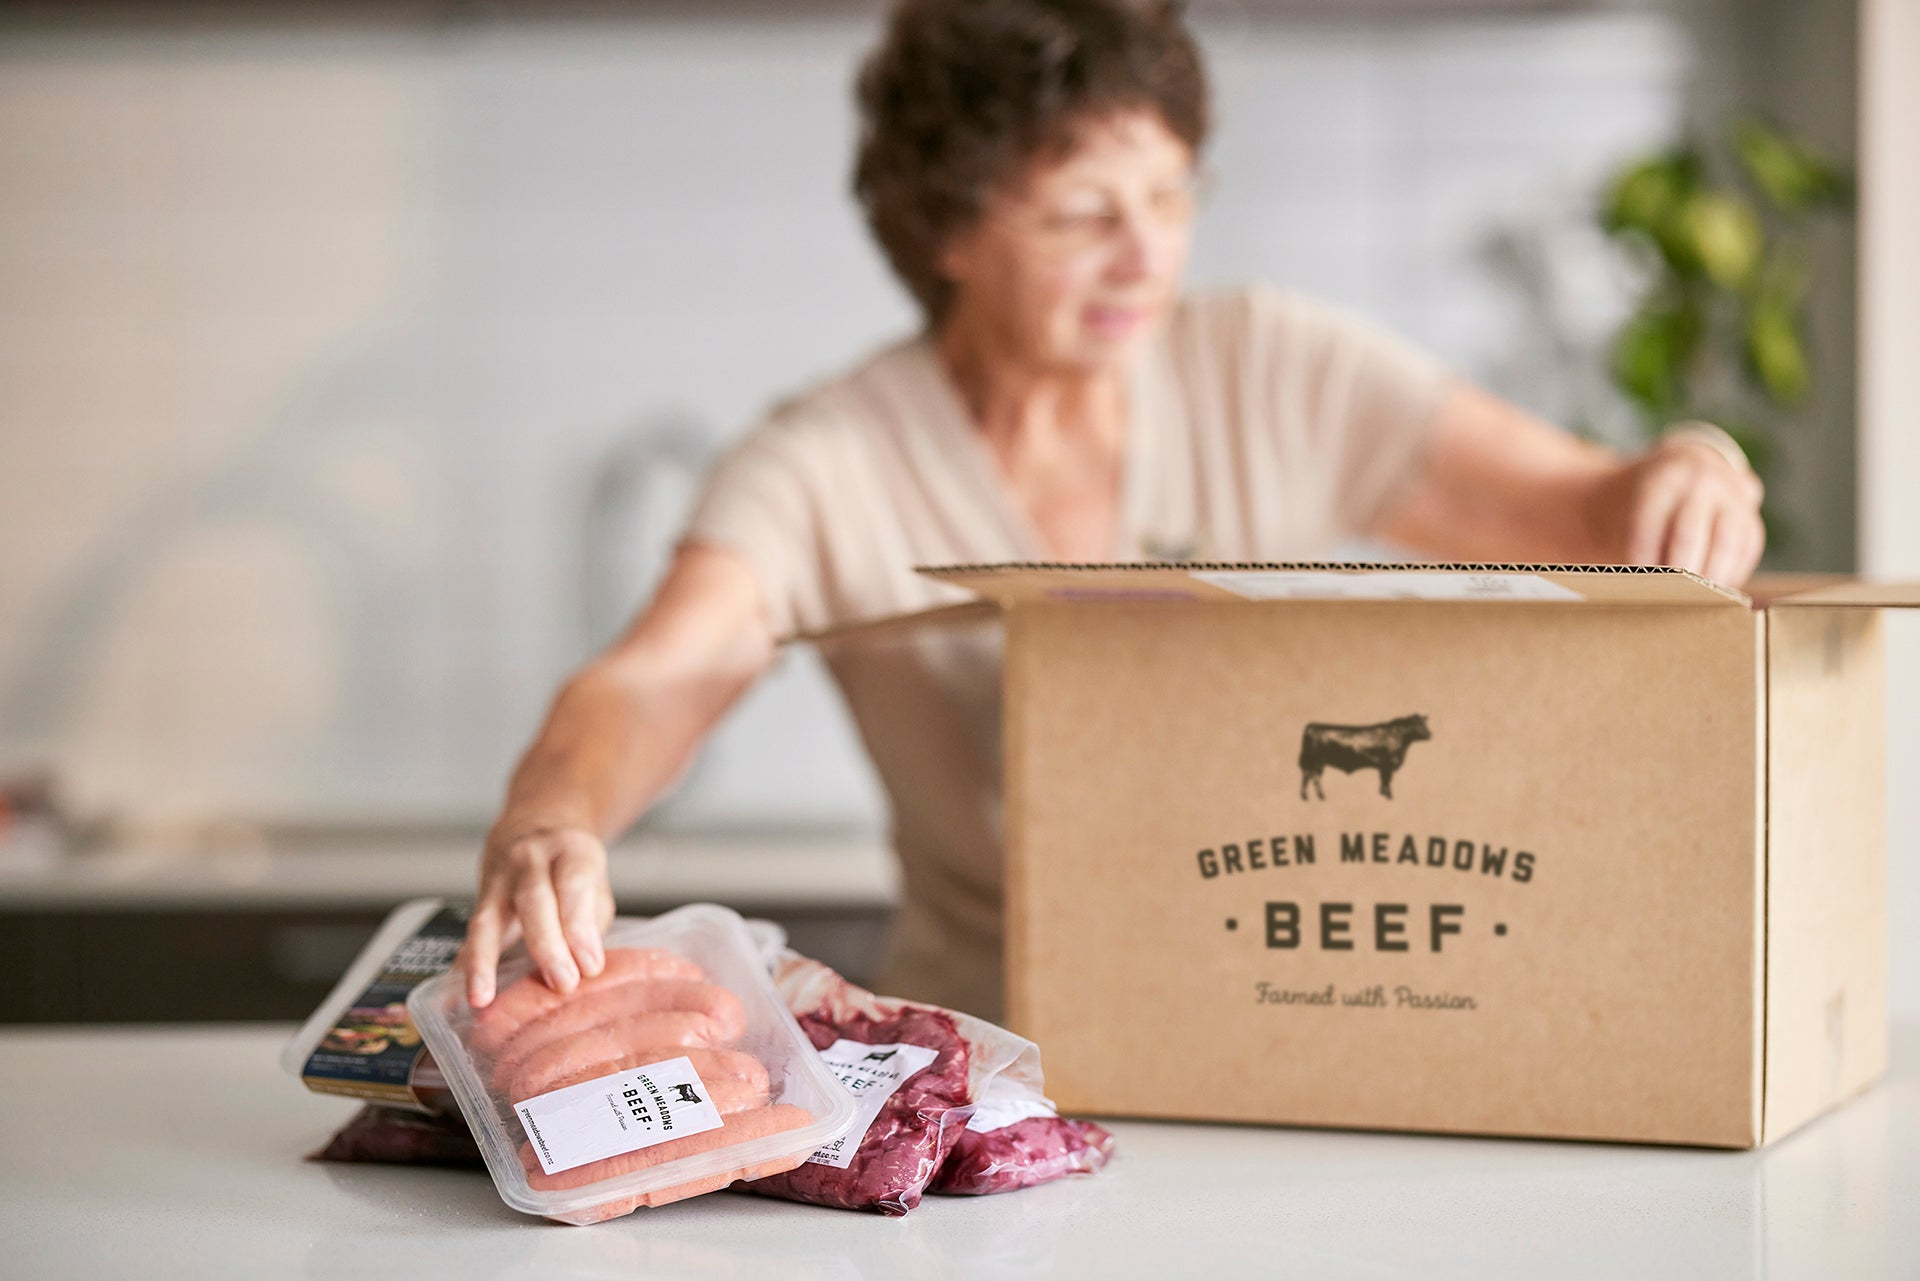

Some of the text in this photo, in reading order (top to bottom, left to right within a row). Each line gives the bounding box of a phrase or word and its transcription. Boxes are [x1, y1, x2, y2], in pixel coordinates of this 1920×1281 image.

[1197, 832, 1537, 883] GREEN MEADOWS
[1265, 902, 1465, 952] BEEF
[1255, 982, 1477, 1011] Farmed with Passion
[622, 1088, 653, 1123] BEEF
[637, 1074, 673, 1131] GREEN MEADOWS
